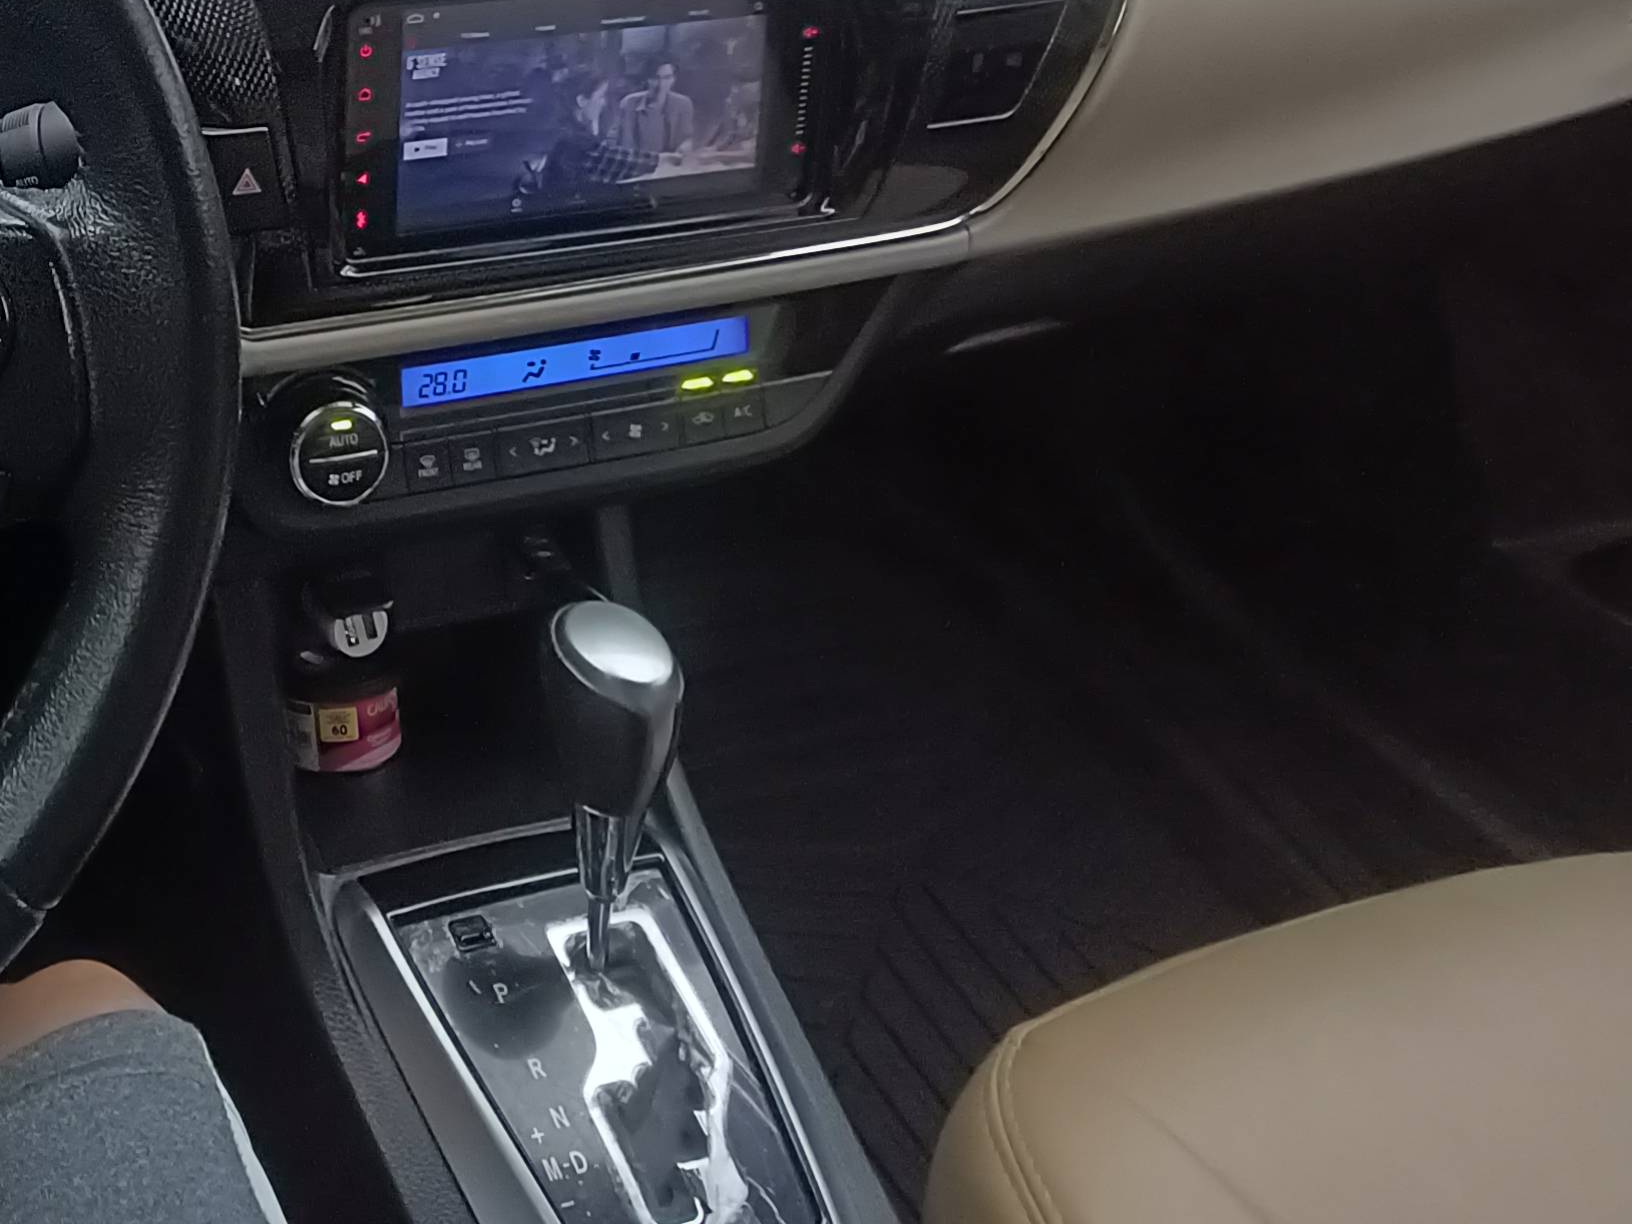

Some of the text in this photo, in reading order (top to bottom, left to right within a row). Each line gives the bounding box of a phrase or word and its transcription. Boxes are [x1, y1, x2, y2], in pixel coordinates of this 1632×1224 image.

[418, 369, 468, 400] 28.0
[328, 432, 359, 448] AUTO
[340, 469, 363, 485] OFF
[492, 982, 509, 1004] P
[527, 1057, 547, 1079] R
[549, 1105, 571, 1129] N
